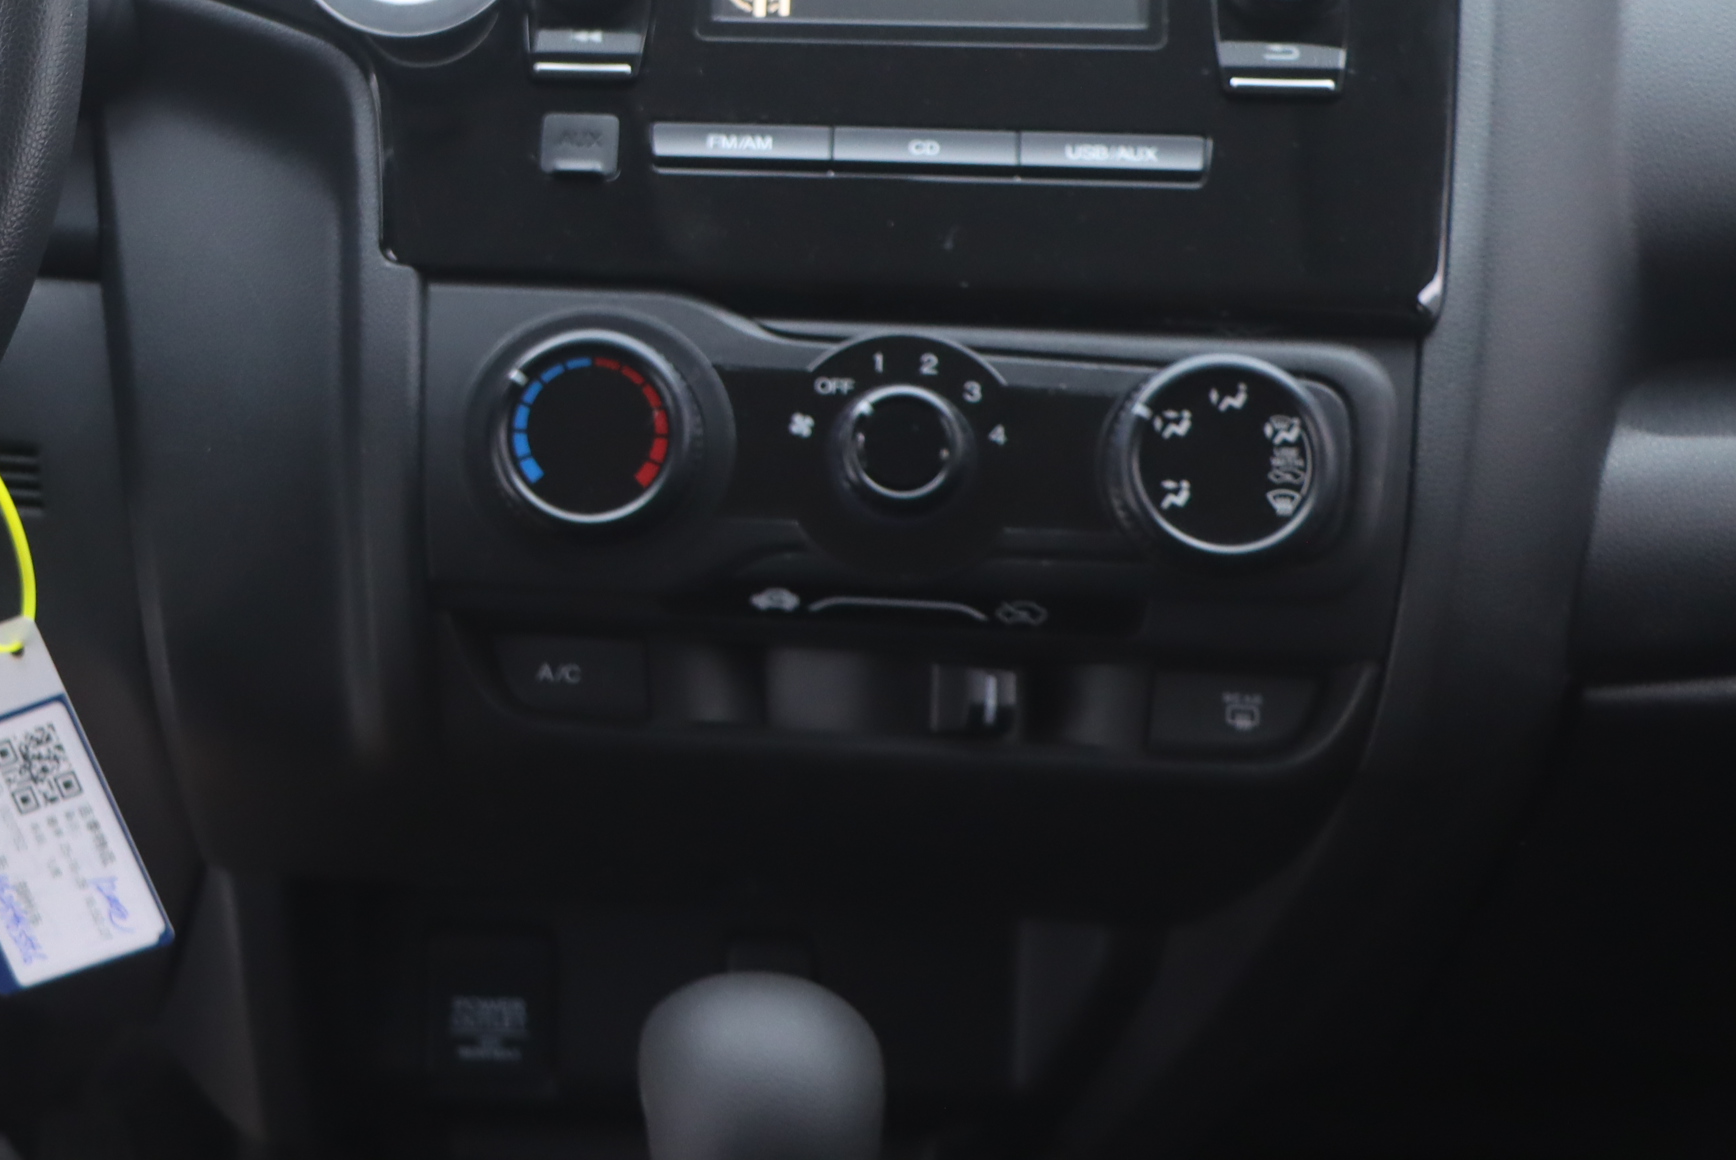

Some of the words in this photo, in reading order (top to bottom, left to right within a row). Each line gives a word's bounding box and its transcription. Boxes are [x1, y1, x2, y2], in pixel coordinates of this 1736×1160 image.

[707, 132, 774, 152] FM/AM
[907, 139, 941, 156] CD
[1065, 143, 1159, 162] USB/AUX
[872, 351, 884, 374] 1
[919, 352, 939, 375] 2
[813, 376, 855, 396] OFF
[963, 380, 983, 404] 3
[987, 423, 1008, 446] 4
[536, 661, 582, 684] A/C
